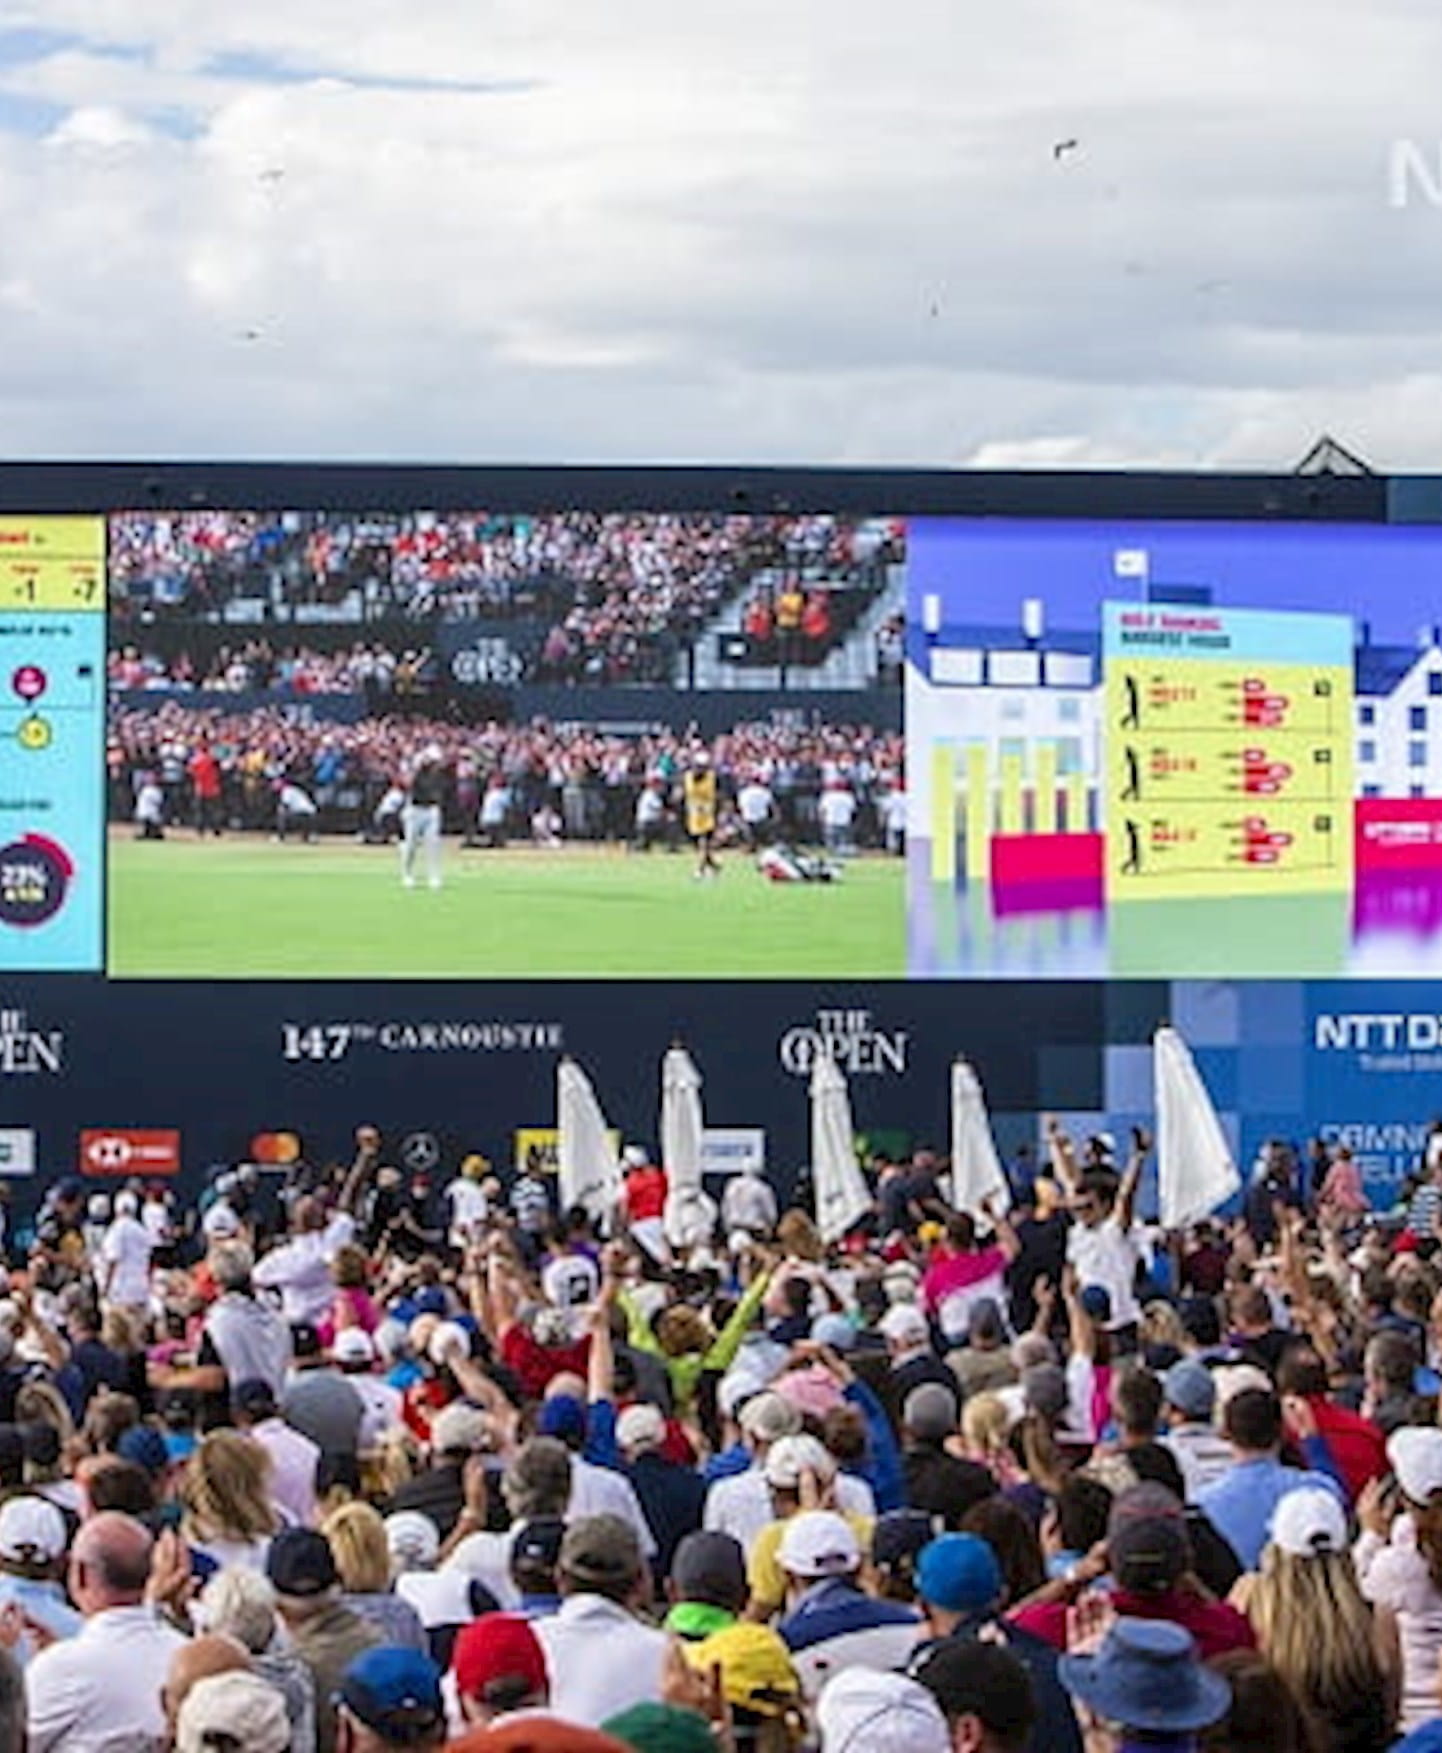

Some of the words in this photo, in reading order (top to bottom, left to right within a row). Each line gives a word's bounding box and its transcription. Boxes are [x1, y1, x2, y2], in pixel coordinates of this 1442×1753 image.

[817, 1010, 872, 1032] THE
[379, 1023, 561, 1050] CARNOUSTIE
[780, 1028, 908, 1074] OPEN
